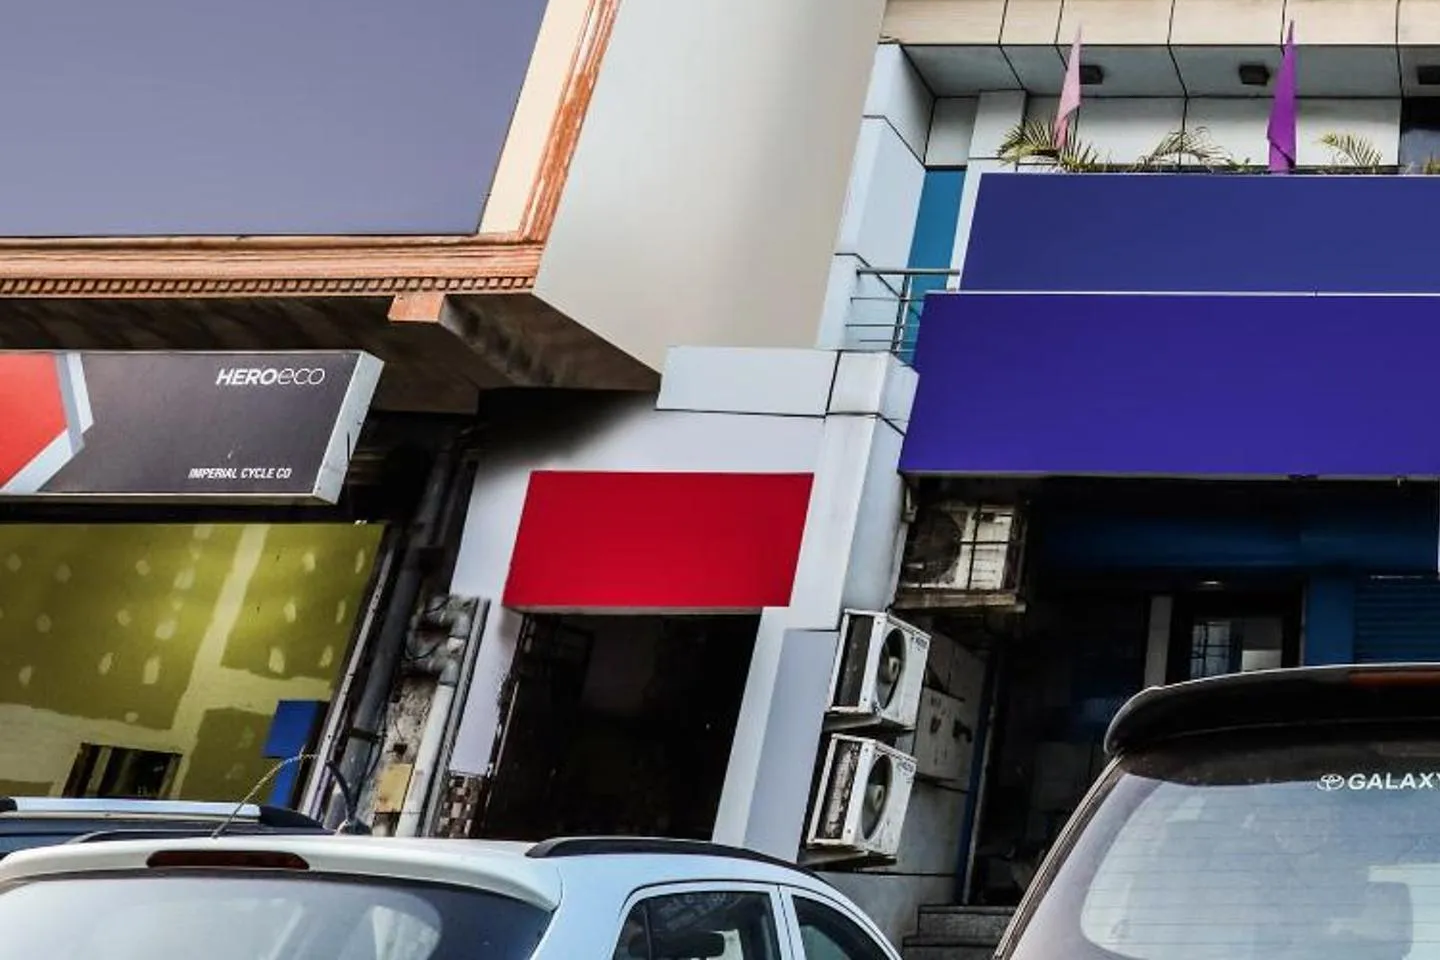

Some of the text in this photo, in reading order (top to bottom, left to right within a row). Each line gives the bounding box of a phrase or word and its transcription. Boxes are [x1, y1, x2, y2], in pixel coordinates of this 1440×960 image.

[187, 467, 293, 480] IMPERIAL CYCLE CO
